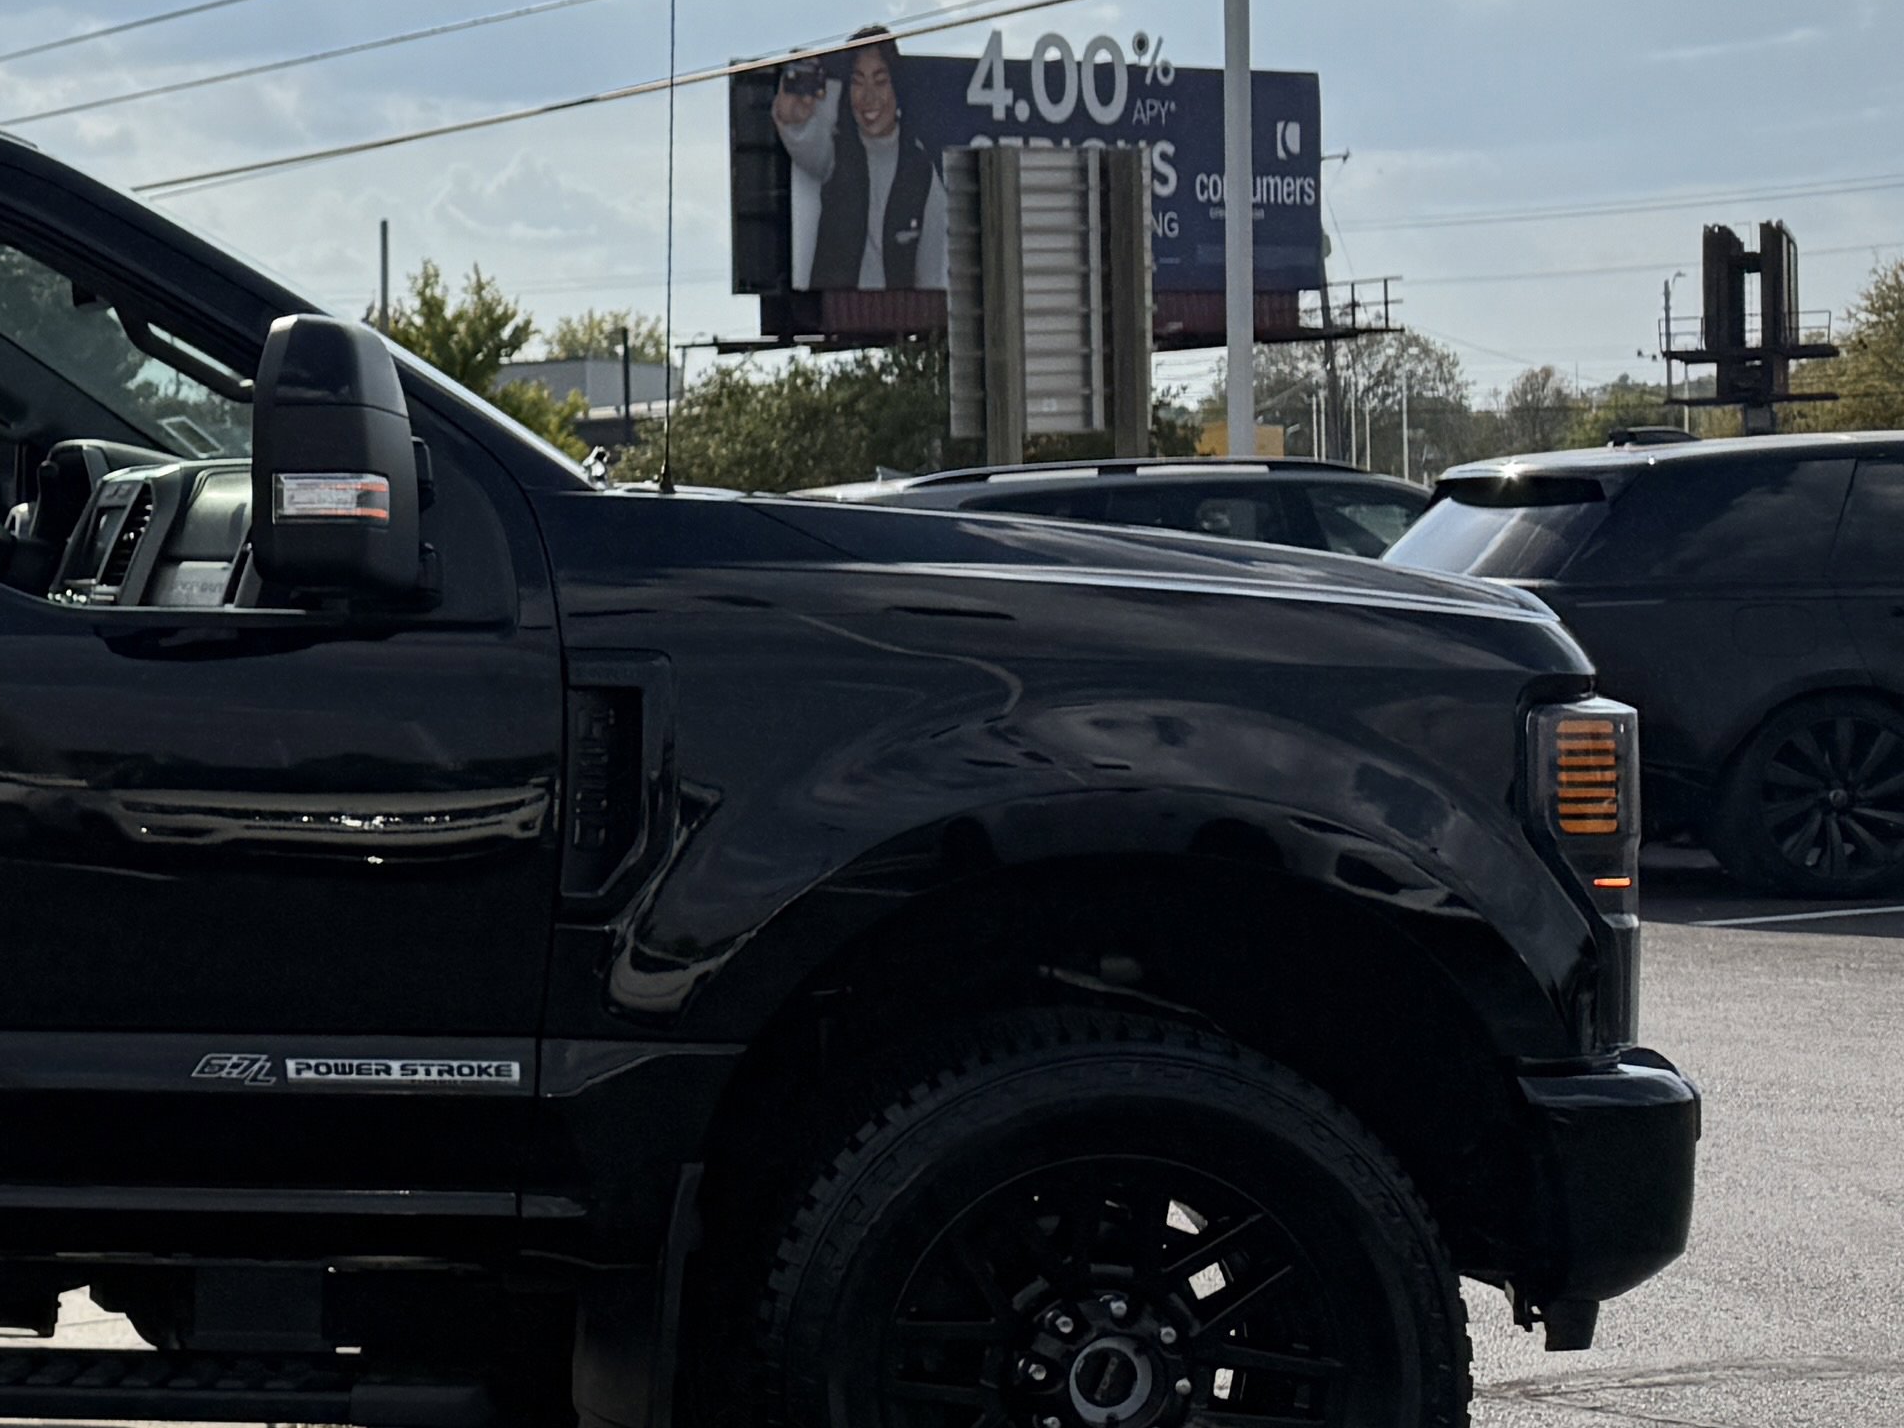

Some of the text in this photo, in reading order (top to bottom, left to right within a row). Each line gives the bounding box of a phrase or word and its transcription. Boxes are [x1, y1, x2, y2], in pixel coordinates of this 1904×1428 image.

[1195, 173, 1316, 206] coumers
[294, 1061, 392, 1077] POWER
[399, 1062, 513, 1078] STROKE
